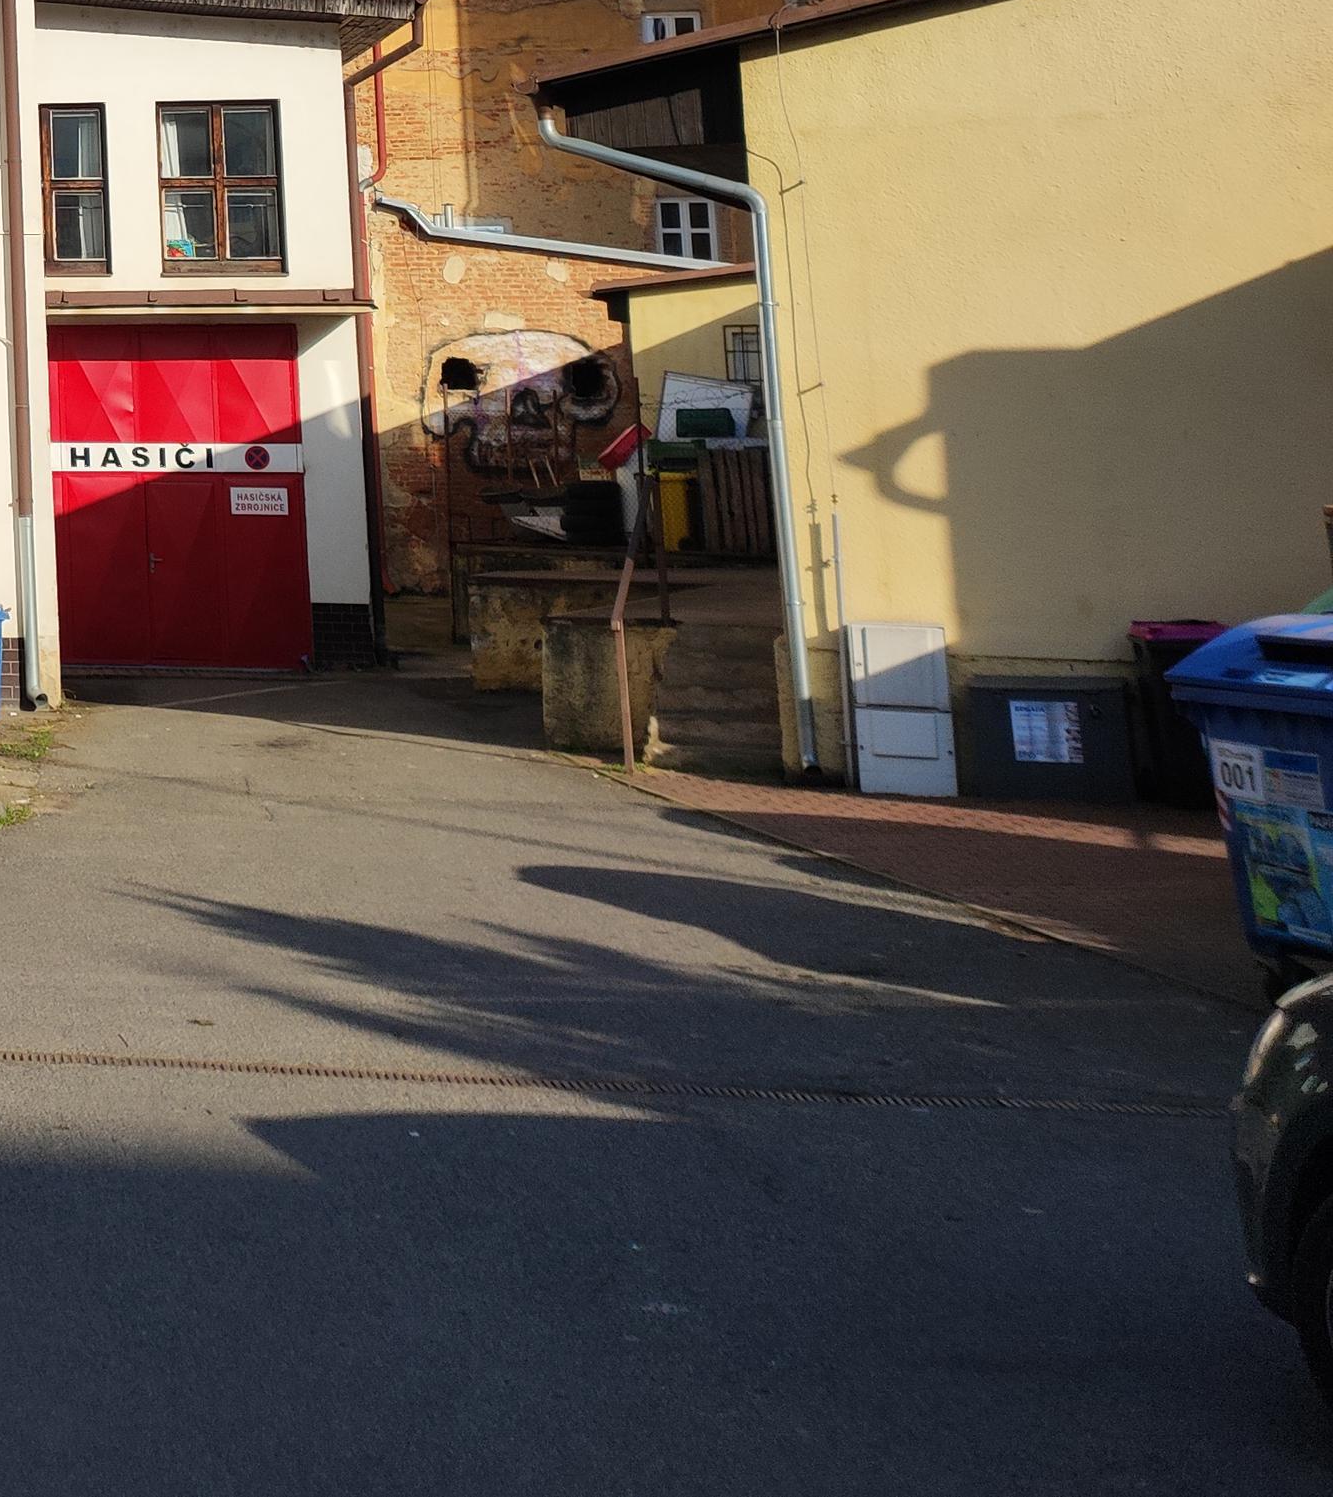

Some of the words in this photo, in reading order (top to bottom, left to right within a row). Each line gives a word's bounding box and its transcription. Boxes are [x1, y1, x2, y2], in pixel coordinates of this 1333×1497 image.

[70, 443, 214, 469] HASIČI
[236, 491, 283, 502] HASIČSKÁ
[235, 503, 285, 512] ZBROJNICE
[1220, 761, 1256, 792] 001
